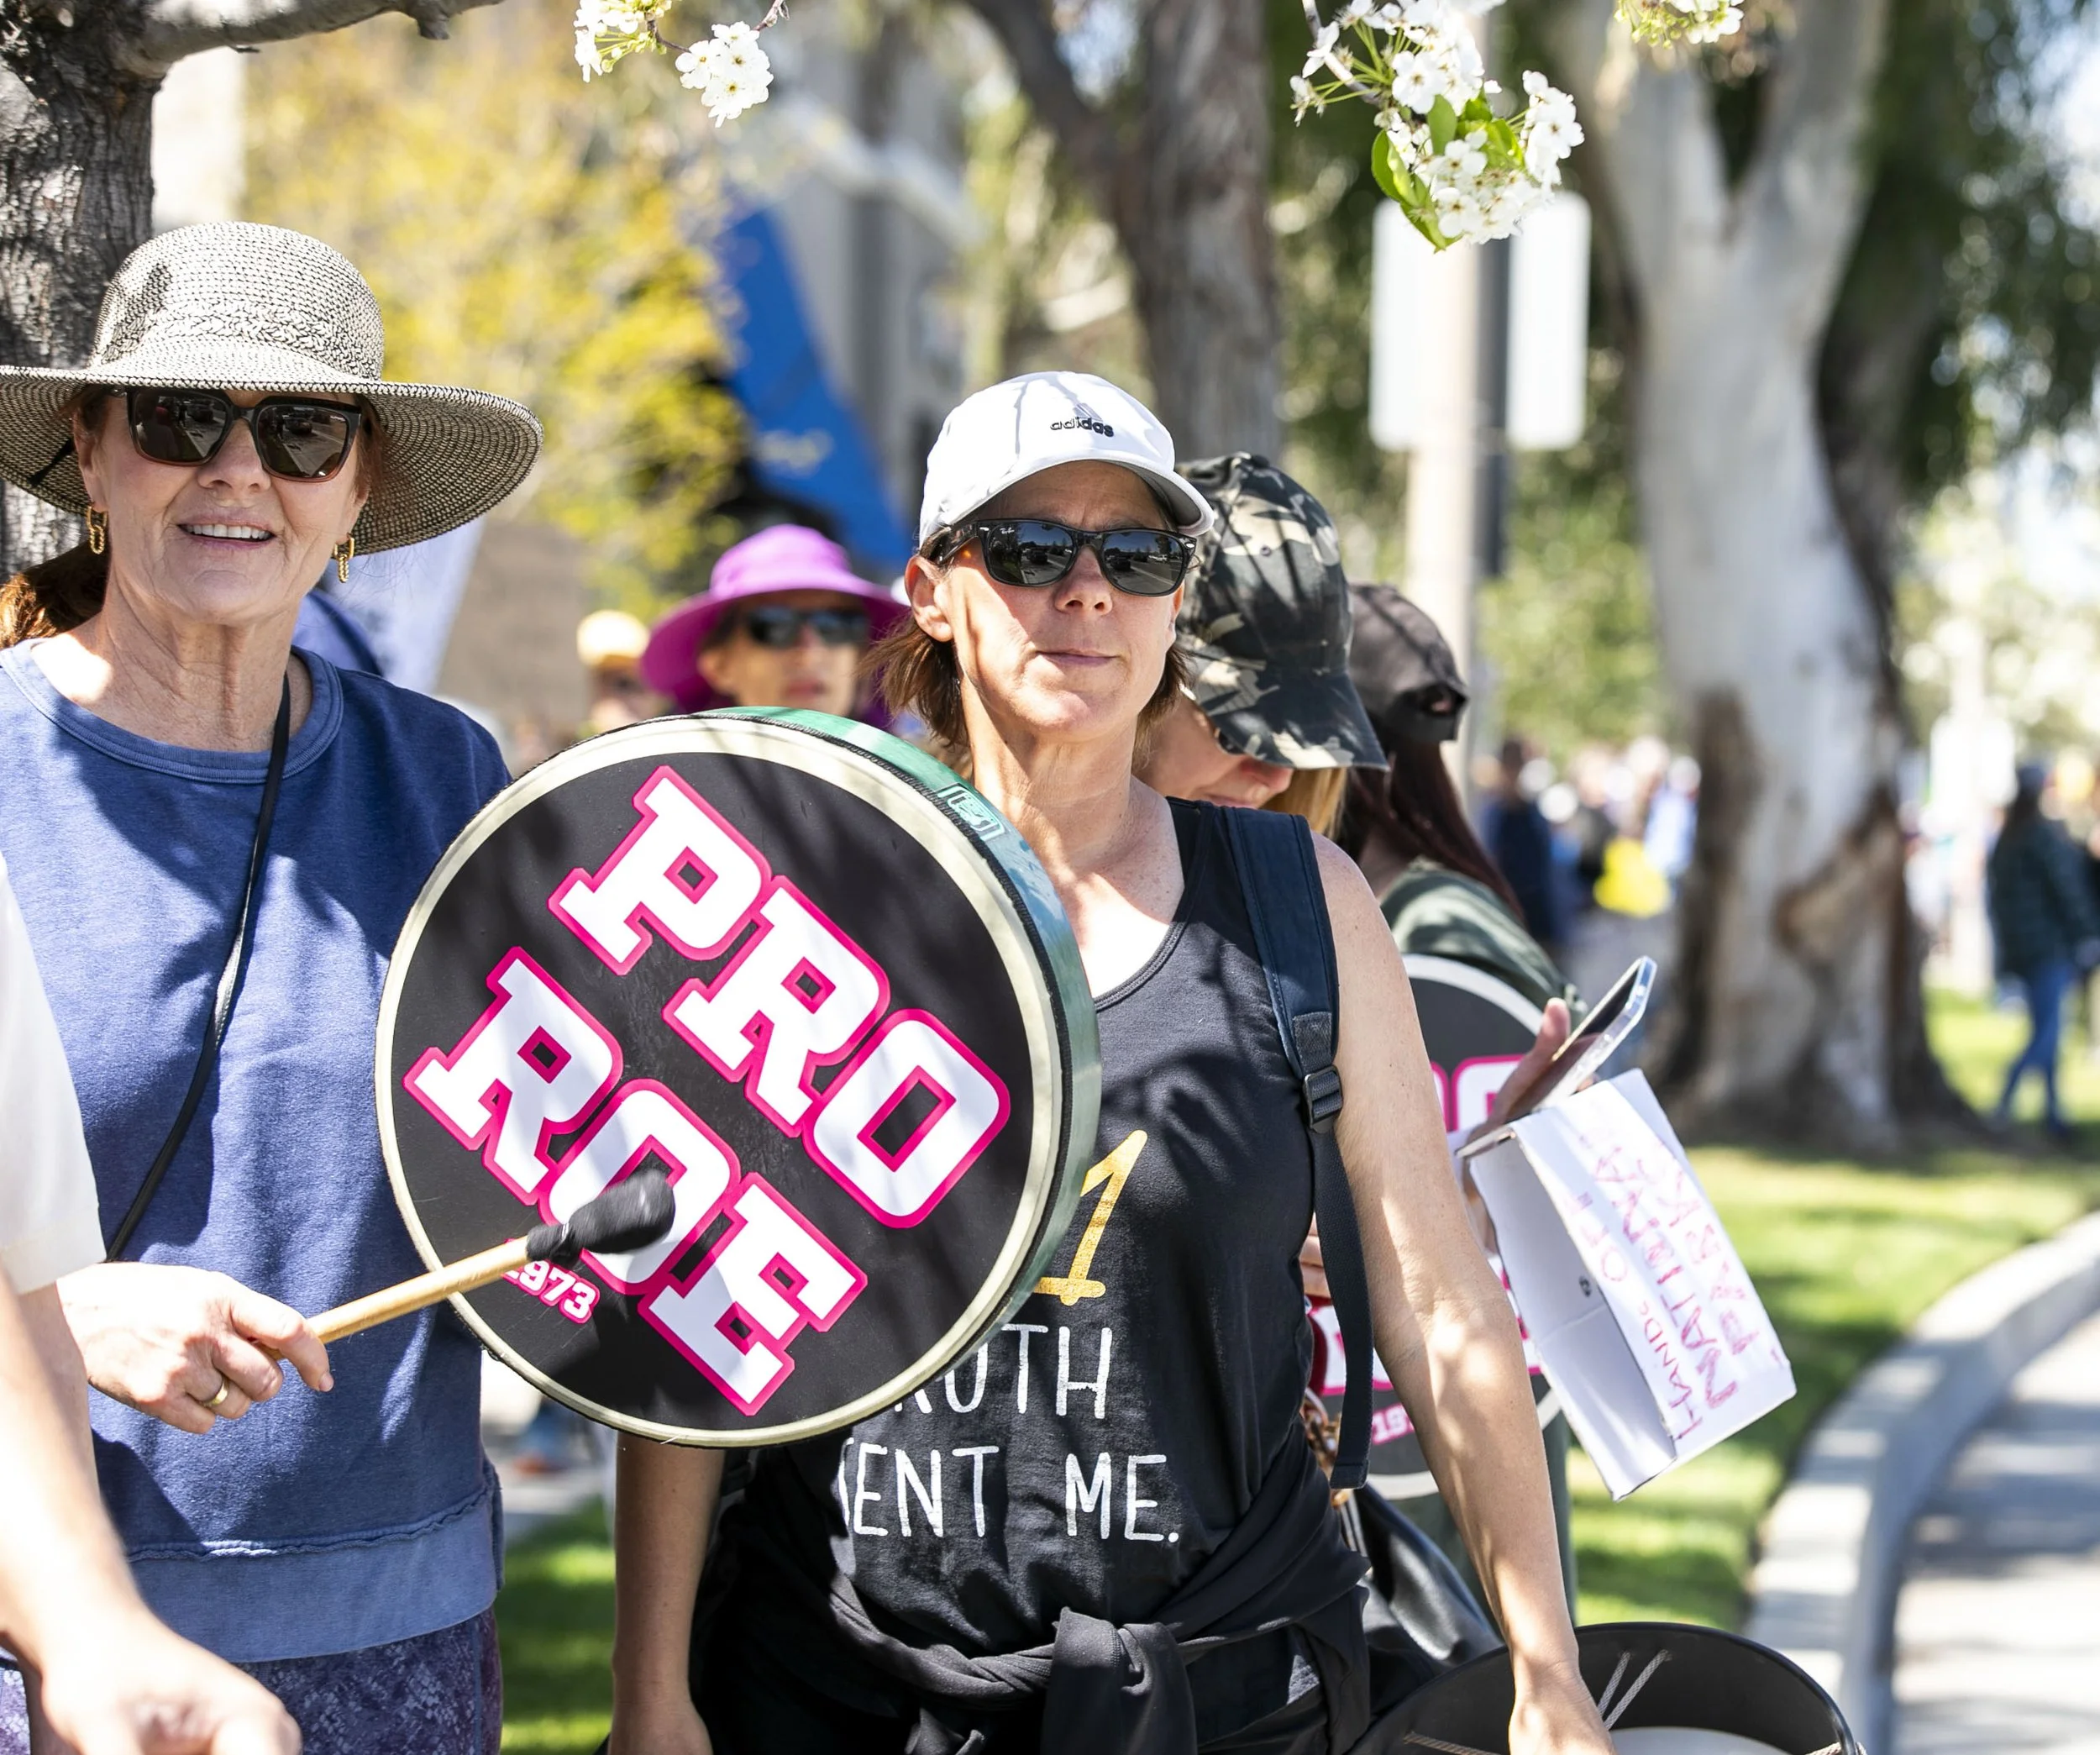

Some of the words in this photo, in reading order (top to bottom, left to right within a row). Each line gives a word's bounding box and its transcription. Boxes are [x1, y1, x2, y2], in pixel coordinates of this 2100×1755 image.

[1050, 417, 1114, 437] adidas
[548, 765, 1010, 1228] PRO
[403, 947, 868, 1416] ROE
[501, 1258, 600, 1324] 973
[1578, 1126, 1735, 1411] NATIONA
[894, 1323, 1113, 1419] UTH
[1065, 1452, 1179, 1542] ME.
